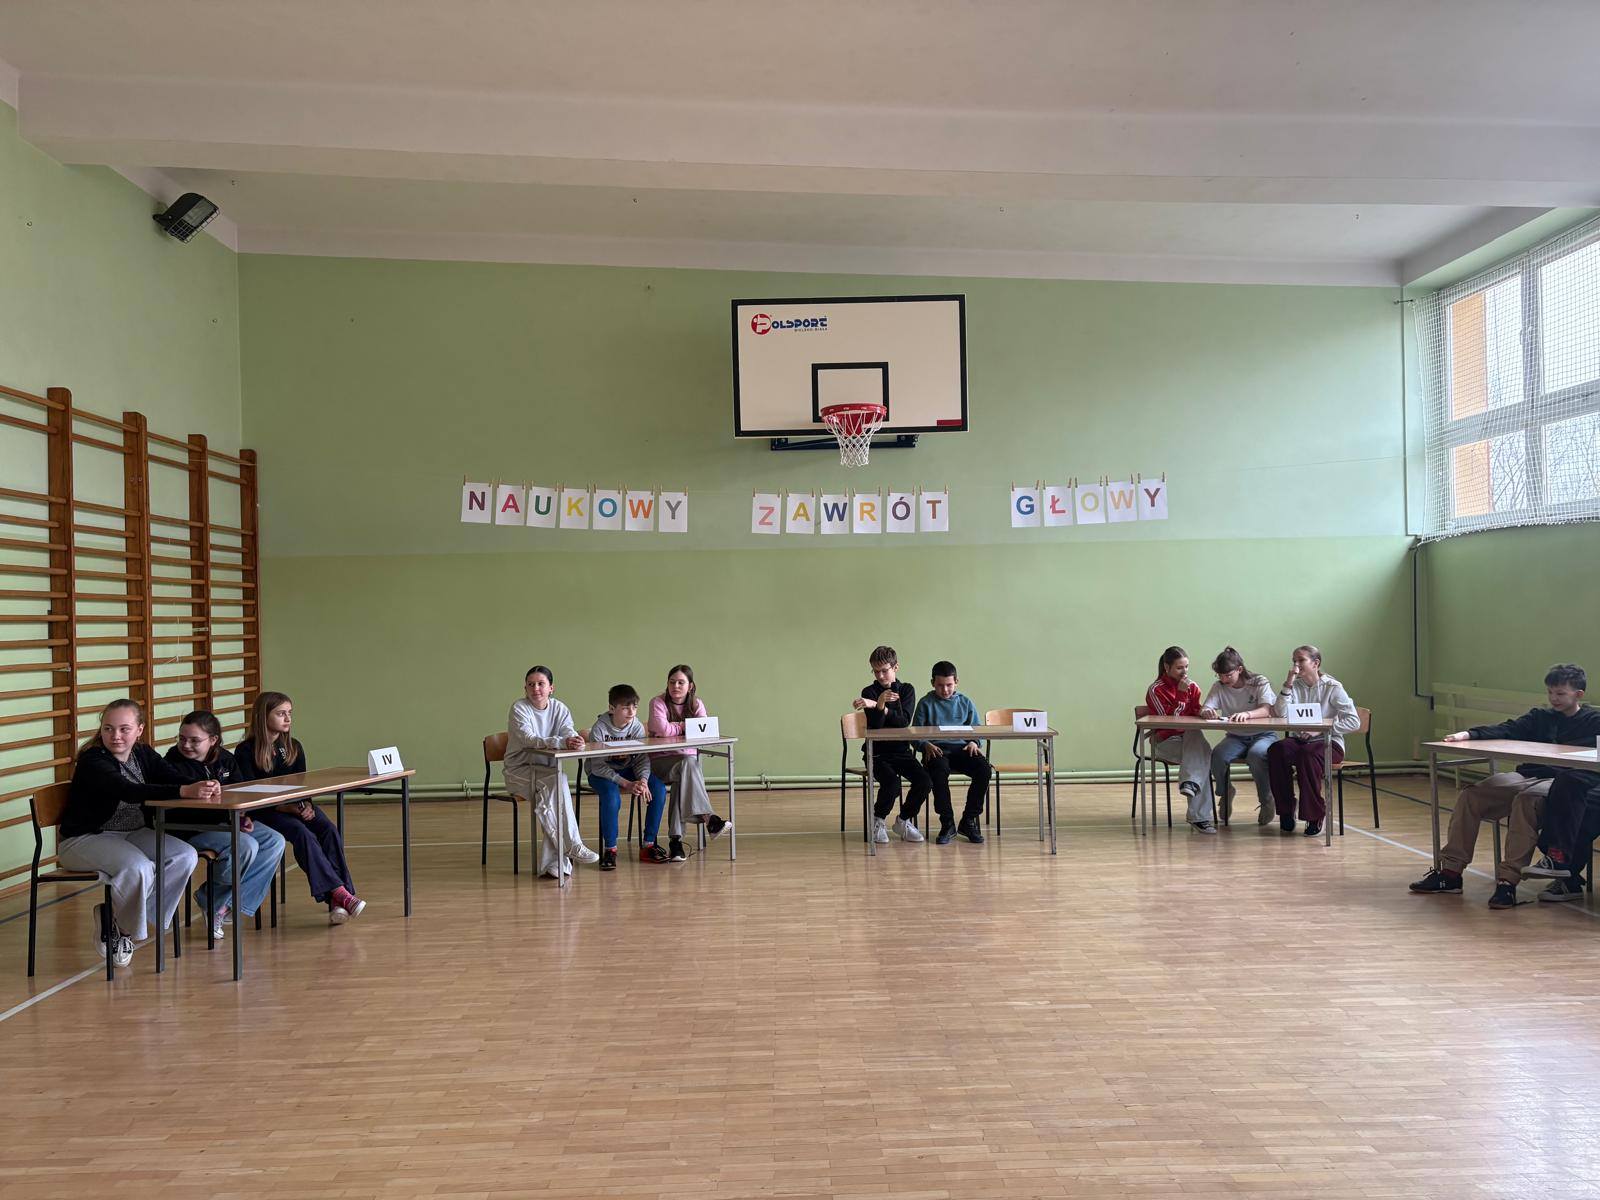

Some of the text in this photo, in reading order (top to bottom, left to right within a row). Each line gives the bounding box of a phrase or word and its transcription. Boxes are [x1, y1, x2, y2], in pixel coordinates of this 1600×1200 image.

[468, 487, 1161, 526] NAUKOWY ZAWRÓT GŁOWY
[1296, 708, 1314, 718] VII
[698, 723, 707, 733] V
[1023, 717, 1037, 728] VI
[381, 753, 392, 766] IV
